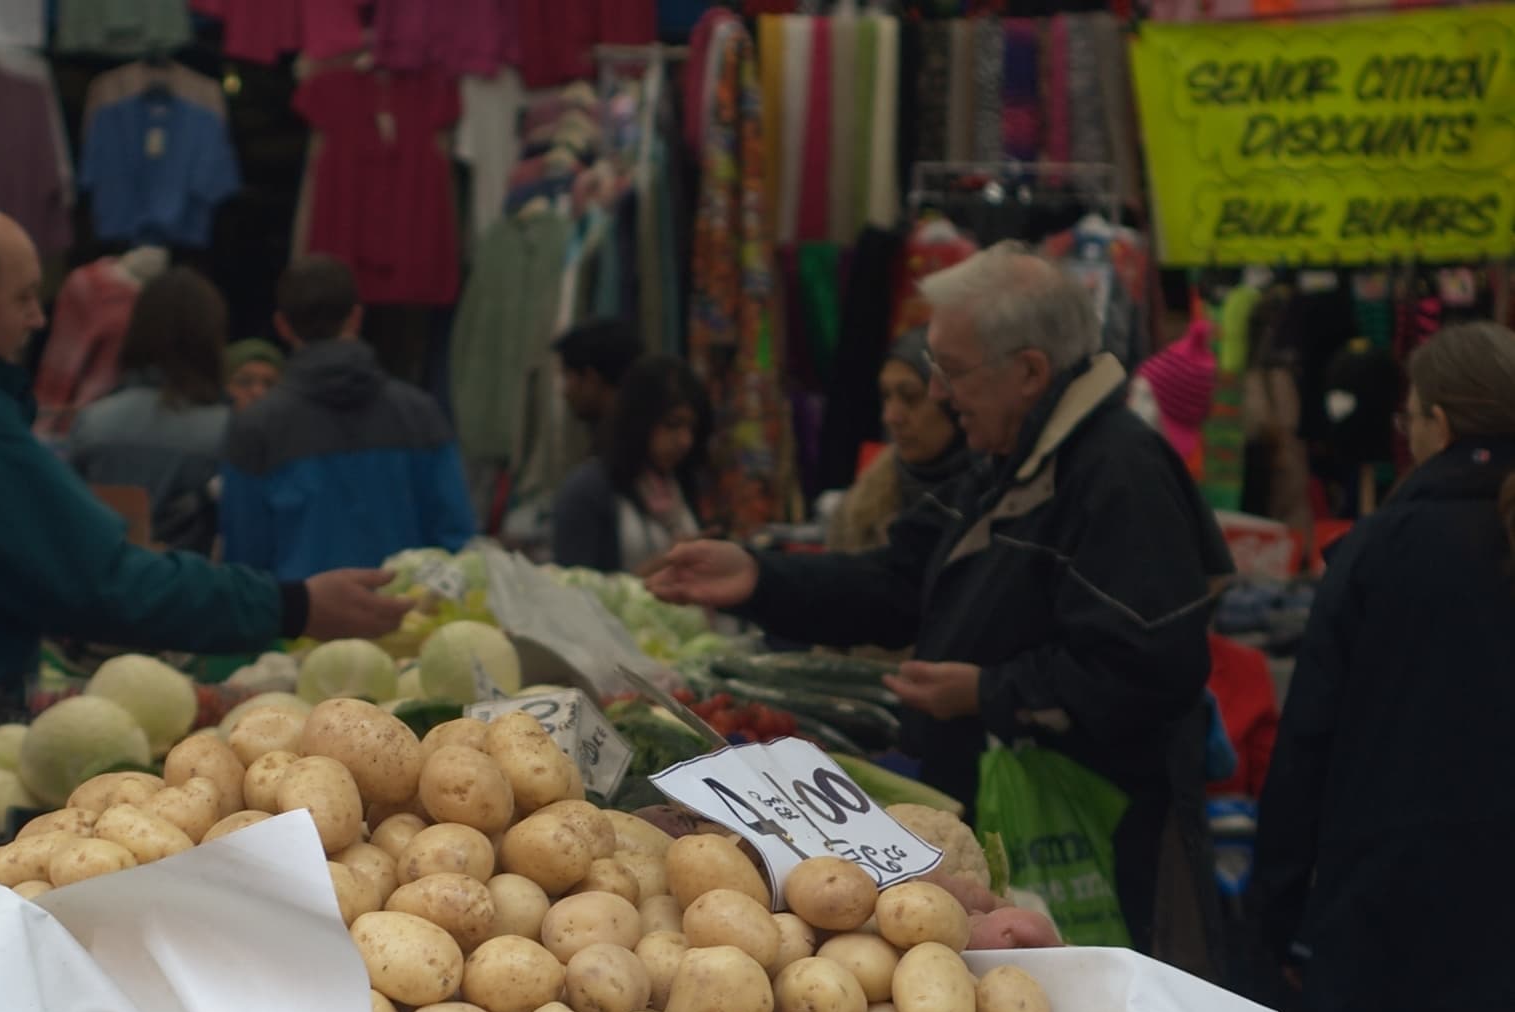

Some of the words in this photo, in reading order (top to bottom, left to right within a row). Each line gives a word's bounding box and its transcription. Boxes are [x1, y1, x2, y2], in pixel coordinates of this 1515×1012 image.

[1189, 57, 1341, 101] SENIOR
[1355, 50, 1498, 102] CITIZEN
[1240, 113, 1478, 158] DISCOUNTS
[1216, 196, 1326, 240] BULK
[1340, 192, 1502, 240] BUYERS
